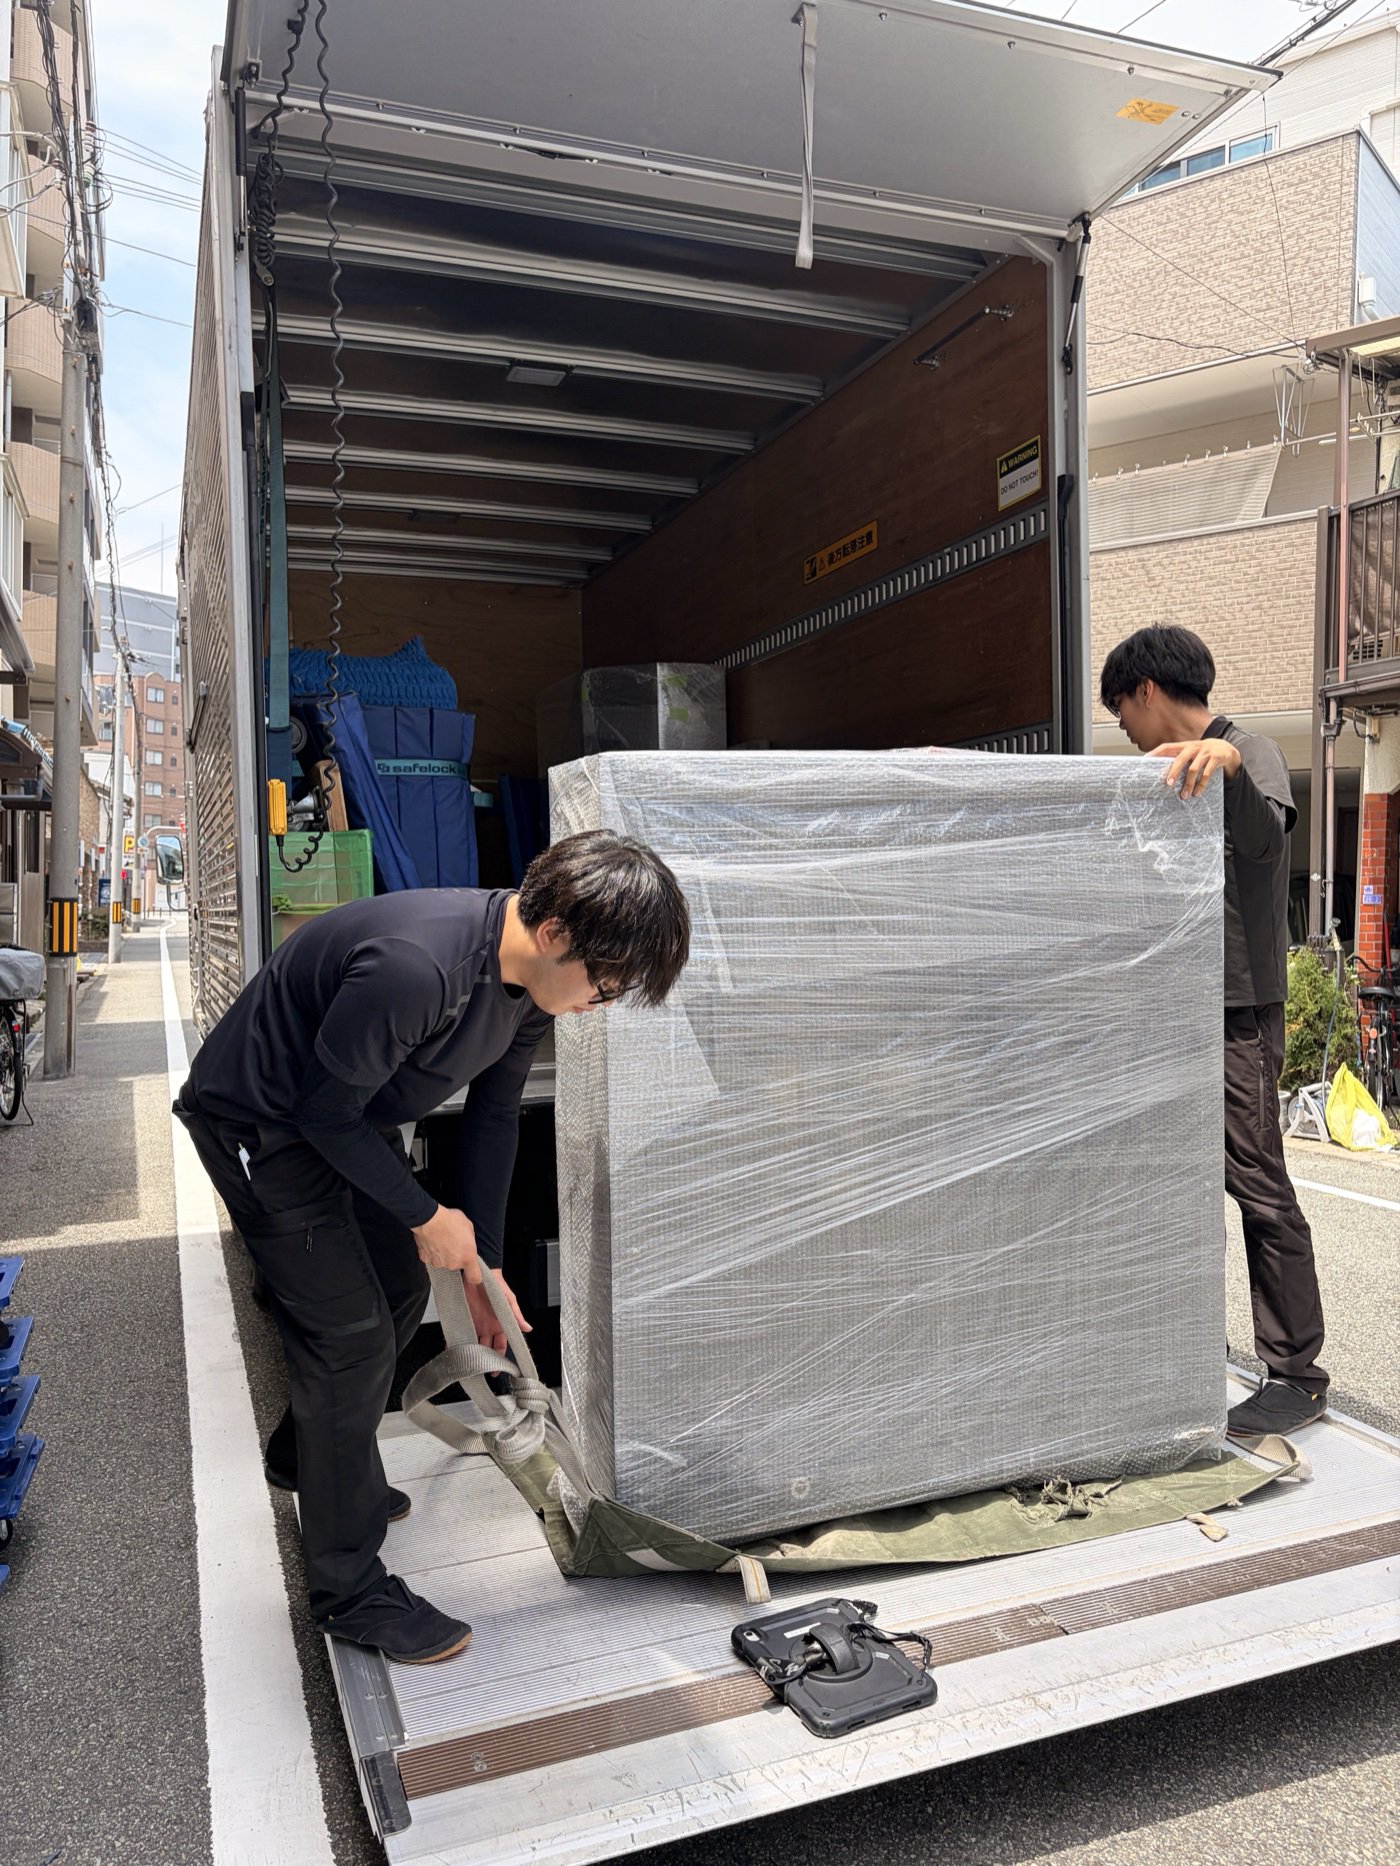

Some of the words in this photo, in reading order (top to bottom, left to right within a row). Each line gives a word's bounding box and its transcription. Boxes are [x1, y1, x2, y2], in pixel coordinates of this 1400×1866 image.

[1007, 445, 1038, 468] WARNING
[1001, 486, 1008, 495] DO
[1009, 479, 1019, 490] NOT
[392, 762, 457, 774] safelock
[124, 835, 135, 854] P
